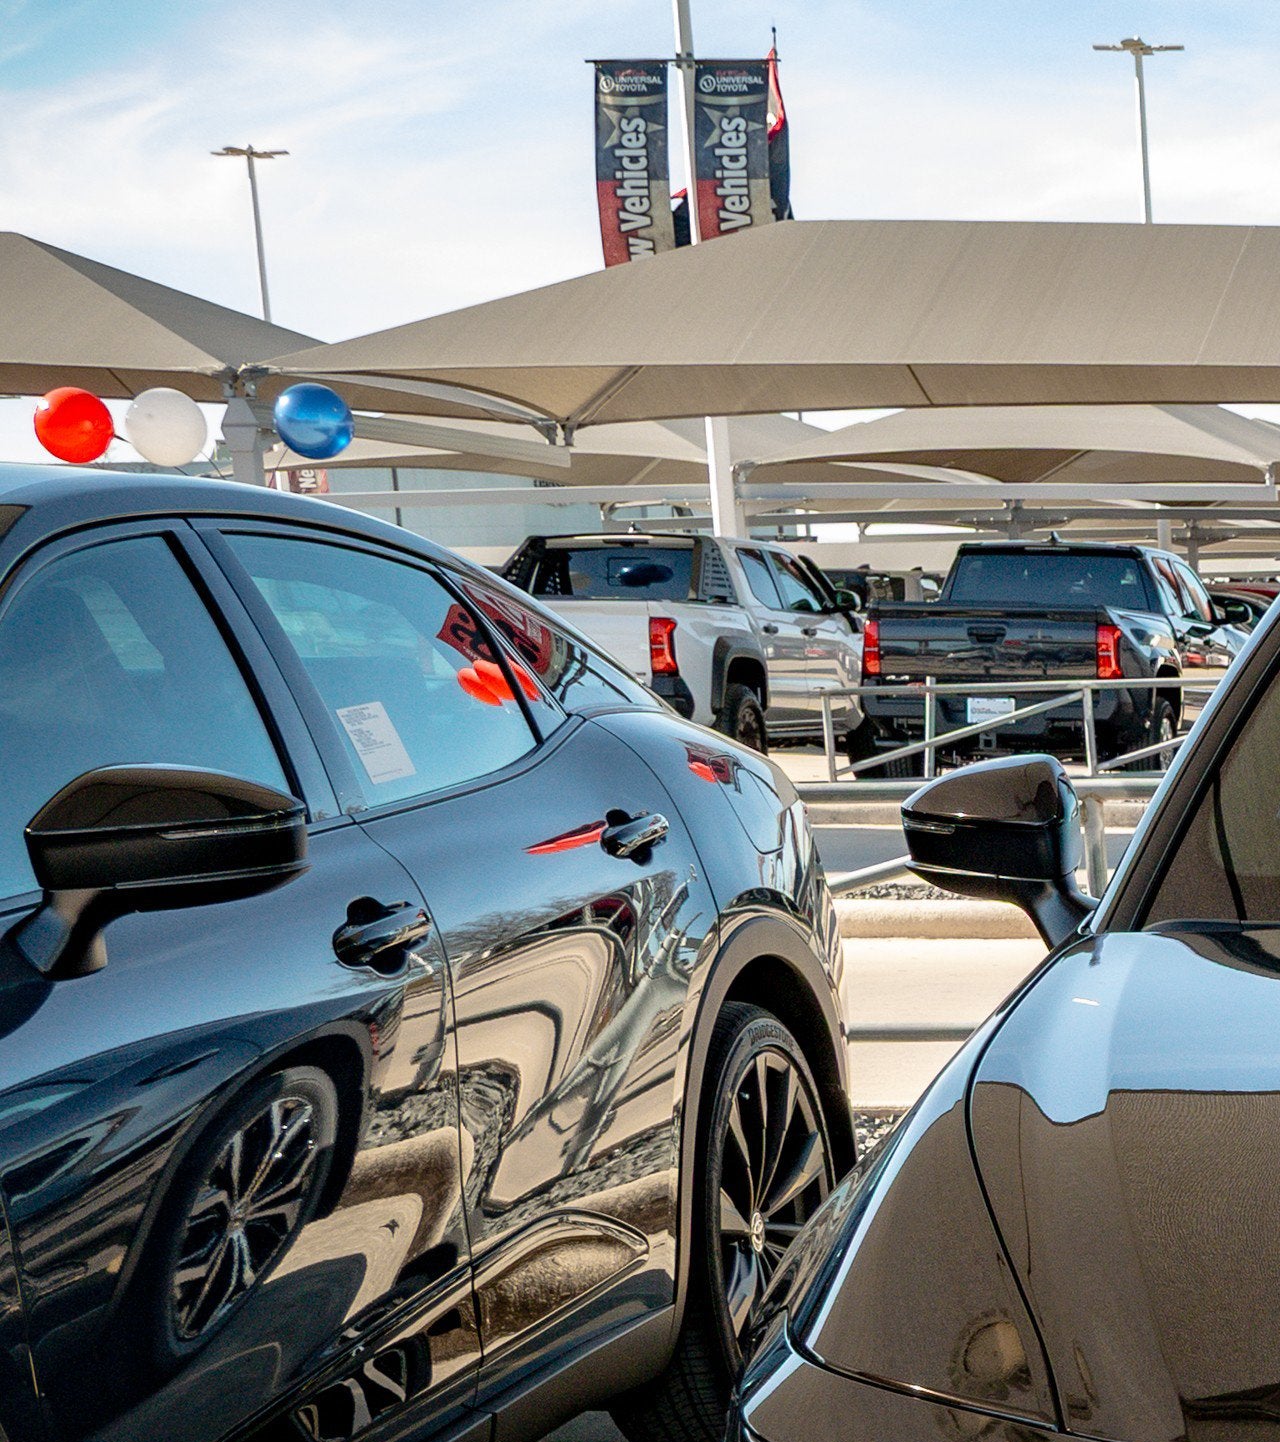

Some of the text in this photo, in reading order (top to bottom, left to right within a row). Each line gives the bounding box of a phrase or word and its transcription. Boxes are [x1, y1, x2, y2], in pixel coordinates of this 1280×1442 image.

[615, 75, 663, 85] UNIVERSAL
[716, 75, 764, 85] UNIVERSAL
[615, 84, 648, 92] TOYOTA
[717, 84, 748, 92] TOYOTA
[614, 116, 651, 233] Vehicles
[713, 115, 753, 232] Vehicles
[298, 469, 317, 489] Ne
